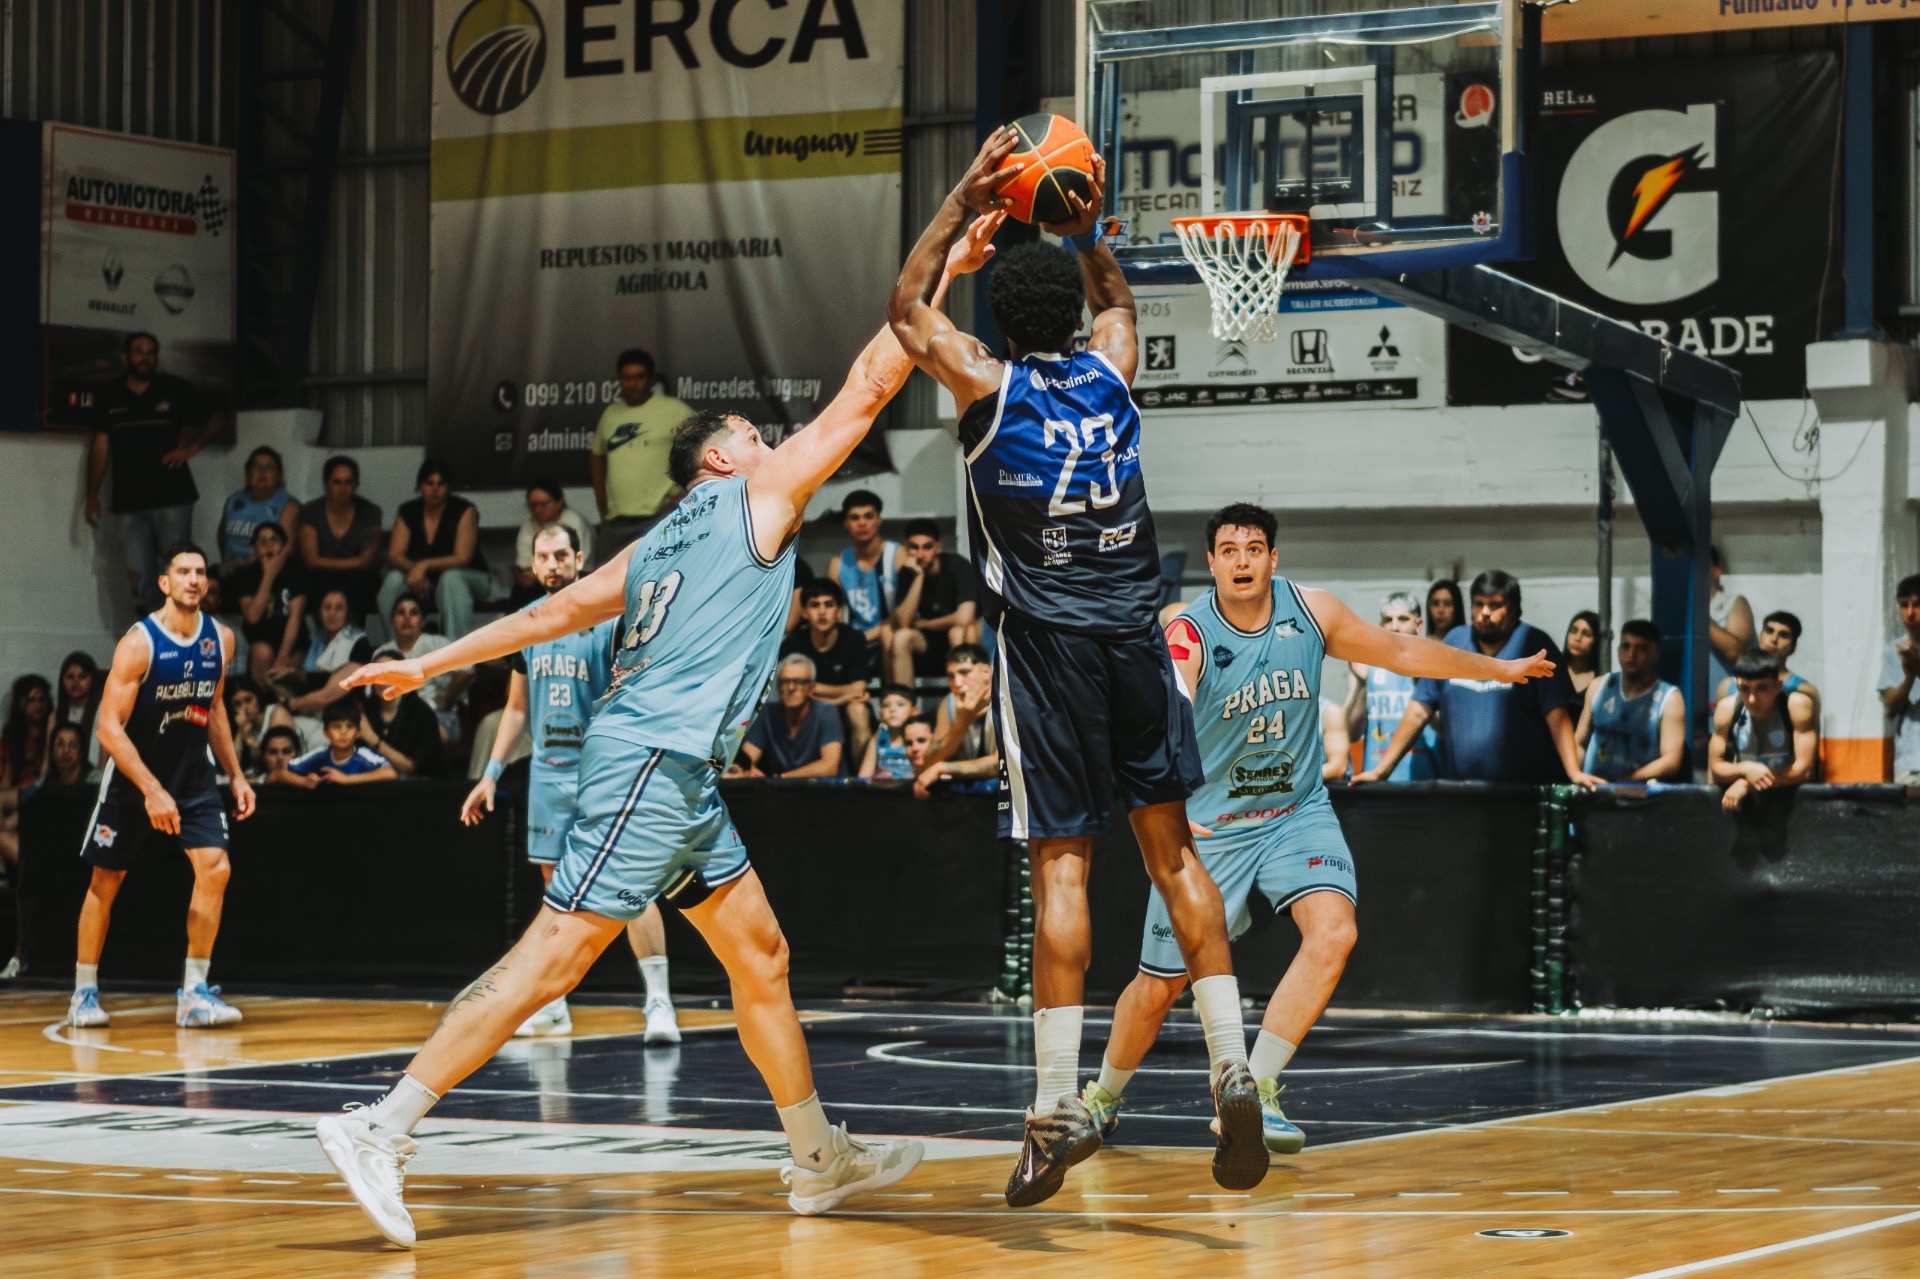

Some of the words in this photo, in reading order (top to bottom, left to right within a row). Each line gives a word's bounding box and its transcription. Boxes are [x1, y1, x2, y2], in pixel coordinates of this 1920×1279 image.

[565, 0, 869, 78] ERCA
[743, 130, 860, 161] Uruguay
[66, 176, 196, 215] AUTOMOTORA
[540, 243, 648, 270] REPUESTOS
[615, 265, 708, 296] AGRÍCOLA
[1286, 366, 1335, 375] HONDA
[525, 382, 558, 407] 099
[565, 380, 596, 405] 210
[677, 376, 761, 400] Mercedes,
[1044, 413, 1121, 517] 23
[532, 653, 590, 682] PRAGA
[549, 683, 572, 706] 23
[1222, 669, 1311, 719] PRAGA
[1246, 710, 1286, 744] 24
